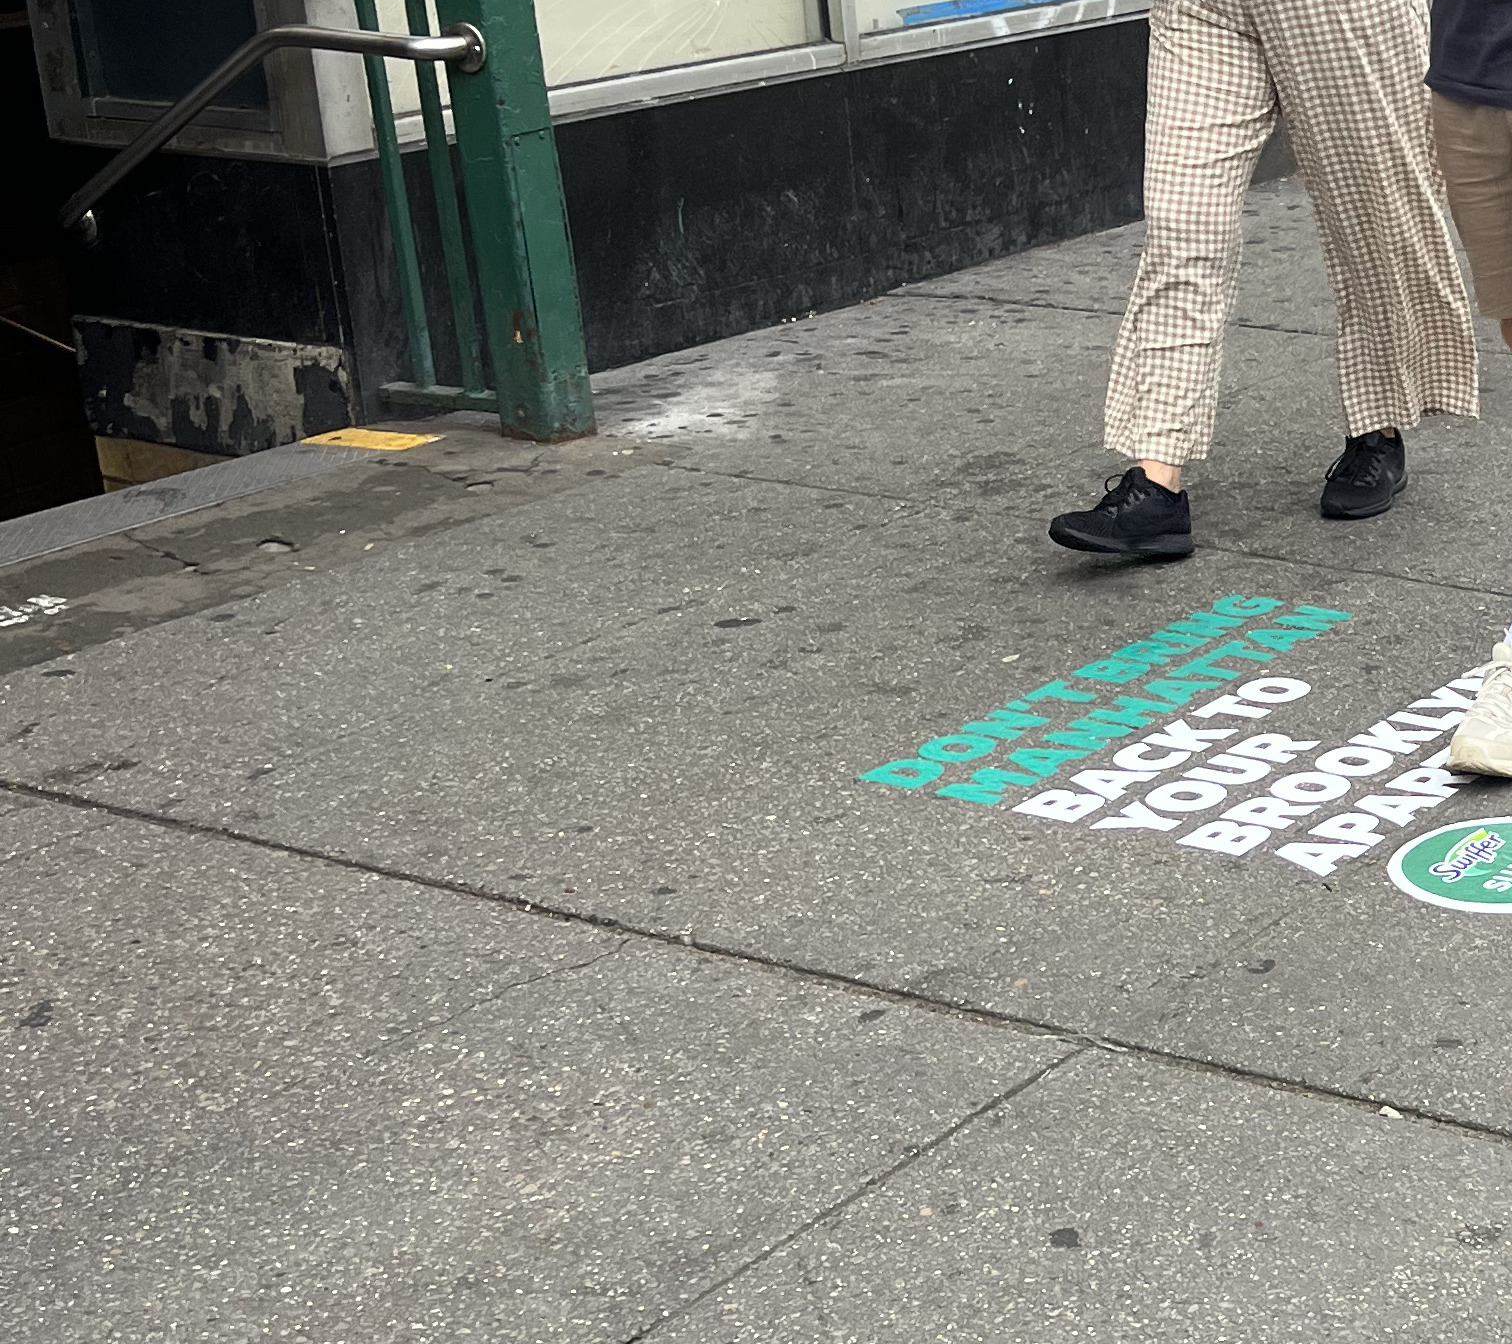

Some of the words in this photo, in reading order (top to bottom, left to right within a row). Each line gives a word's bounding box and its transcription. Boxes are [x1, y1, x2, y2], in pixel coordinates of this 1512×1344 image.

[859, 679, 1098, 789] DON'T
[1072, 594, 1284, 684] BRING
[934, 606, 1353, 805] MANHATTAN
[1011, 718, 1239, 823] BACK
[1190, 676, 1312, 719] TO
[1089, 732, 1322, 832] YOUR
[1431, 833, 1503, 882] Swiffer
